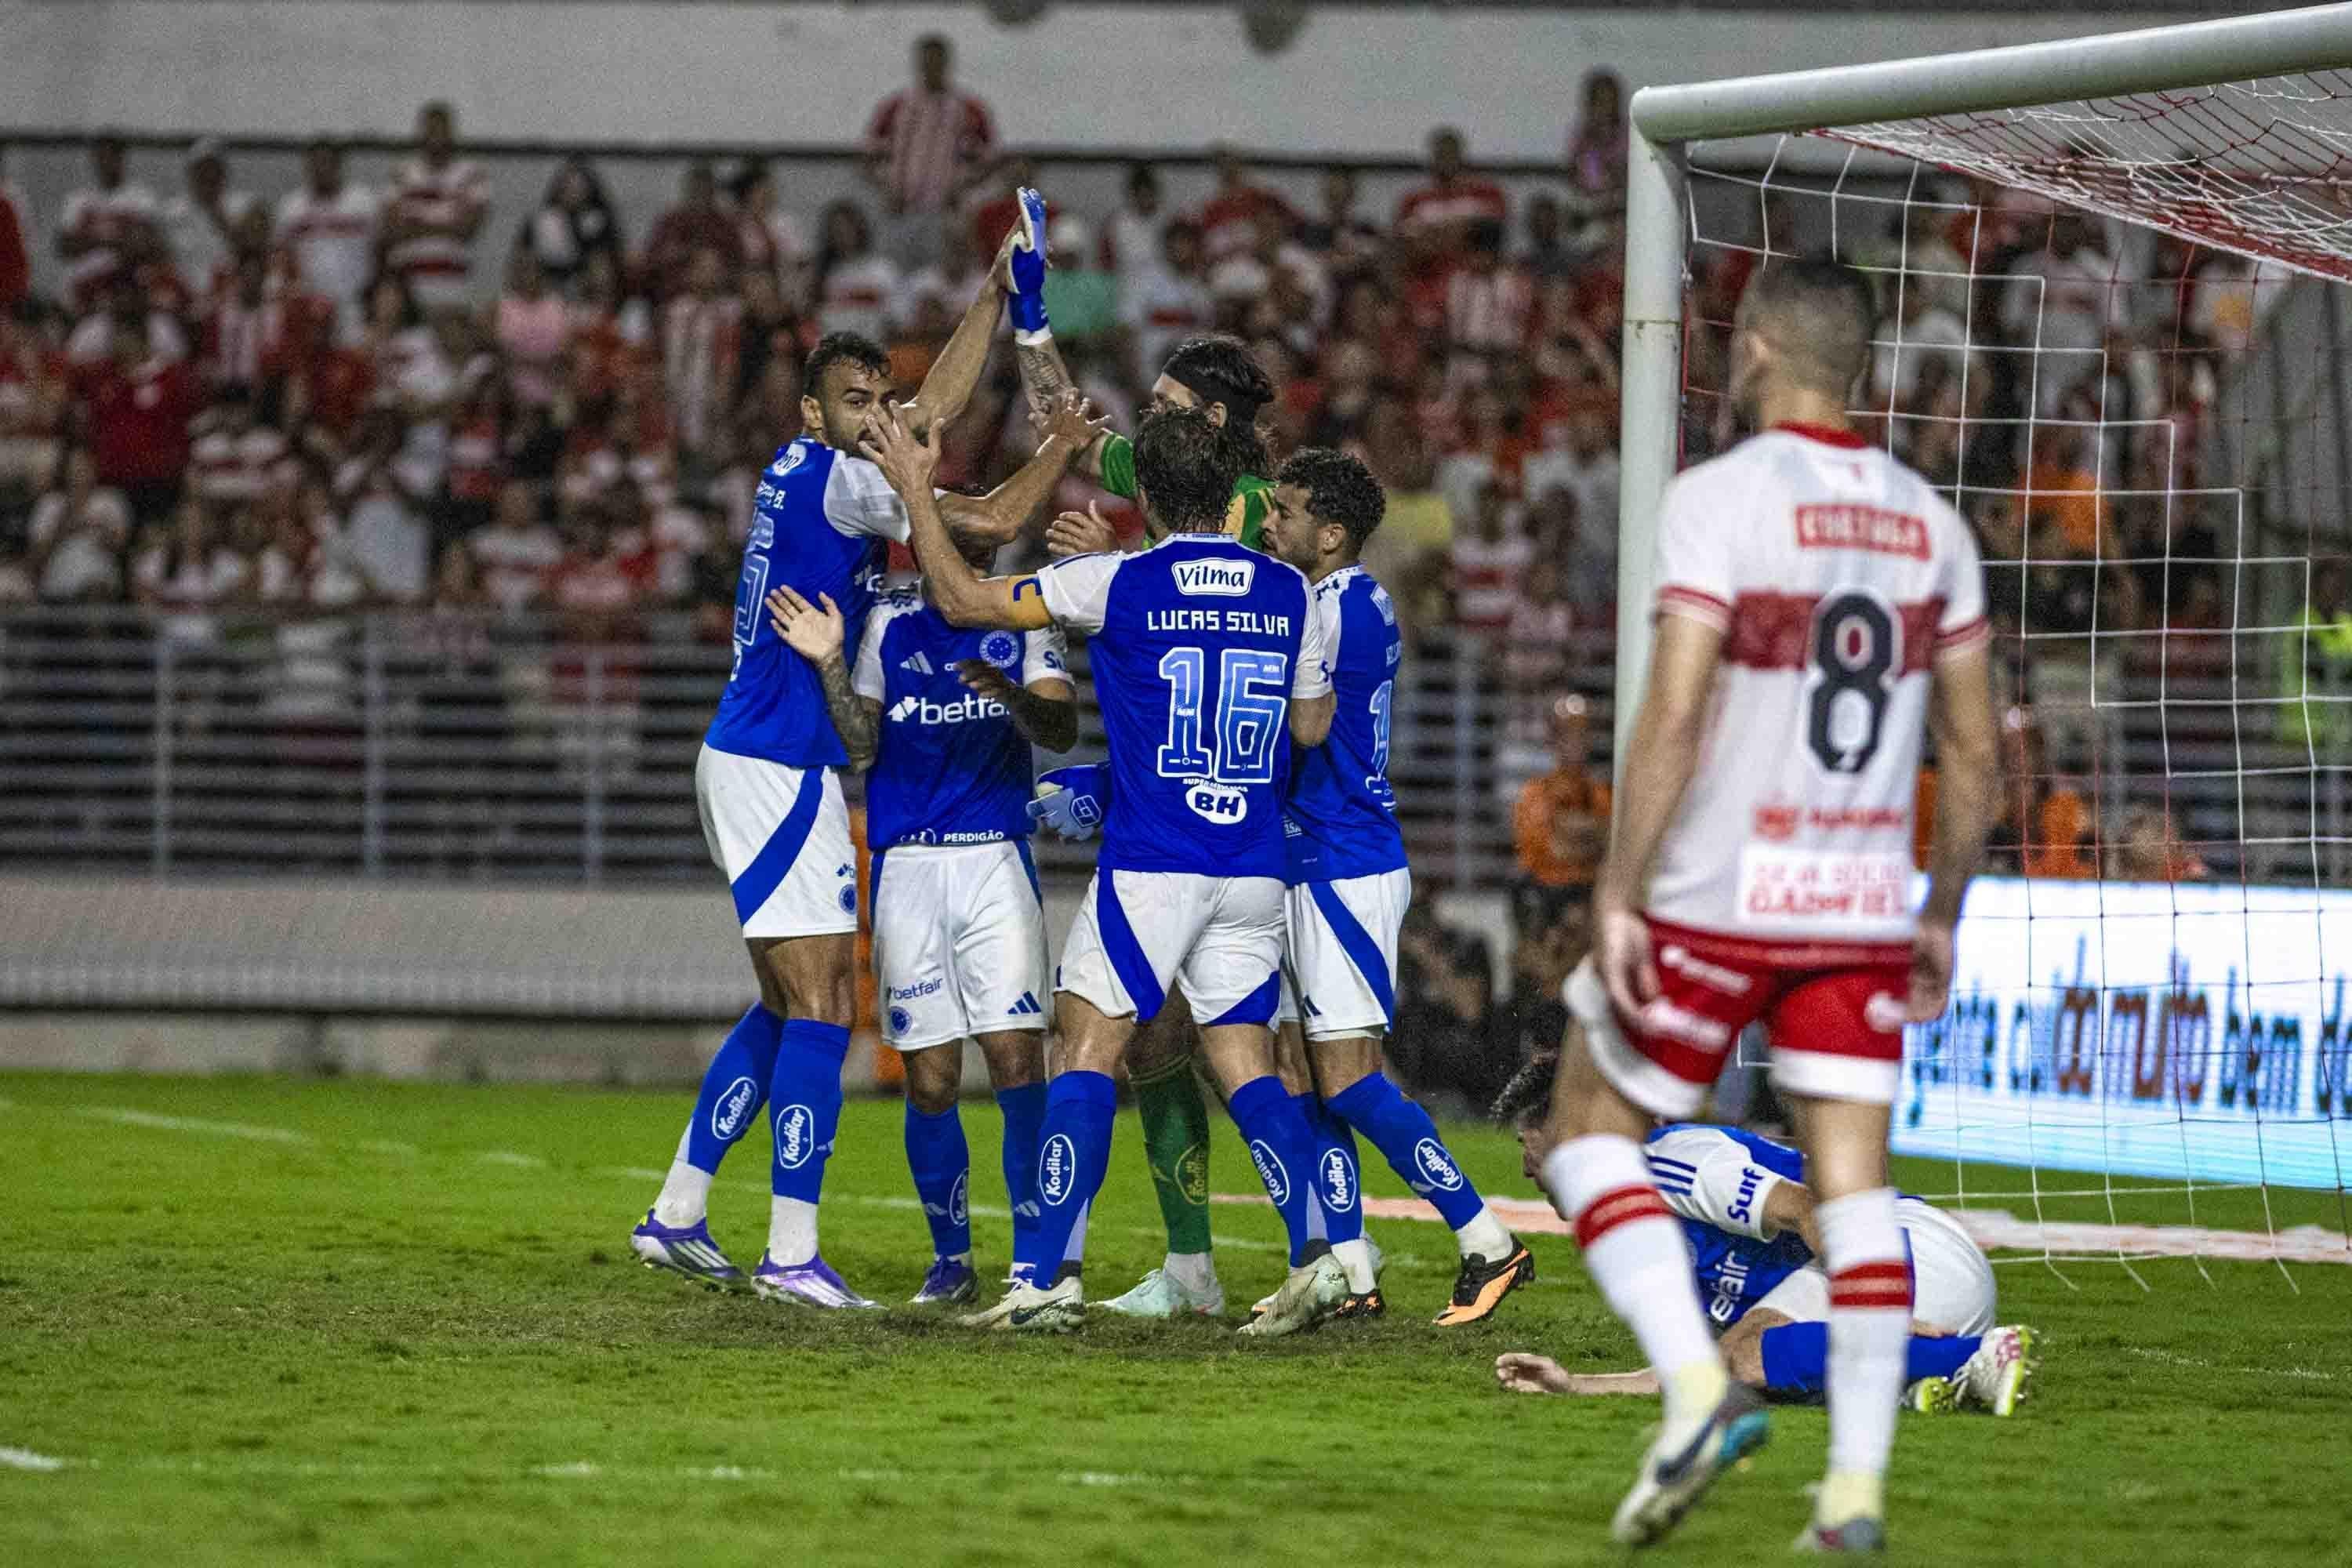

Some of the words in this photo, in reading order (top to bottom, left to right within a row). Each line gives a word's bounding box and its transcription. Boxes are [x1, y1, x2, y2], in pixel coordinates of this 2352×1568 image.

[1178, 565, 1245, 587] Vilma
[1147, 609, 1221, 631] LUCAS
[1225, 612, 1290, 637] SILVA
[1808, 593, 1896, 775] 8
[1157, 646, 1288, 784] 16
[1194, 791, 1241, 817] BH
[943, 829, 1004, 843] PERDIGÃO
[893, 978, 944, 1000] betfair
[717, 1081, 755, 1136] Kodilar
[782, 1108, 807, 1162] Kodilar
[1045, 1140, 1064, 1197] Kodilar
[1253, 1147, 1286, 1200] Kodilar
[1327, 1153, 1349, 1206] Kodilar
[1419, 1145, 1461, 1187] Kodilar
[1727, 1167, 1766, 1224] Surf
